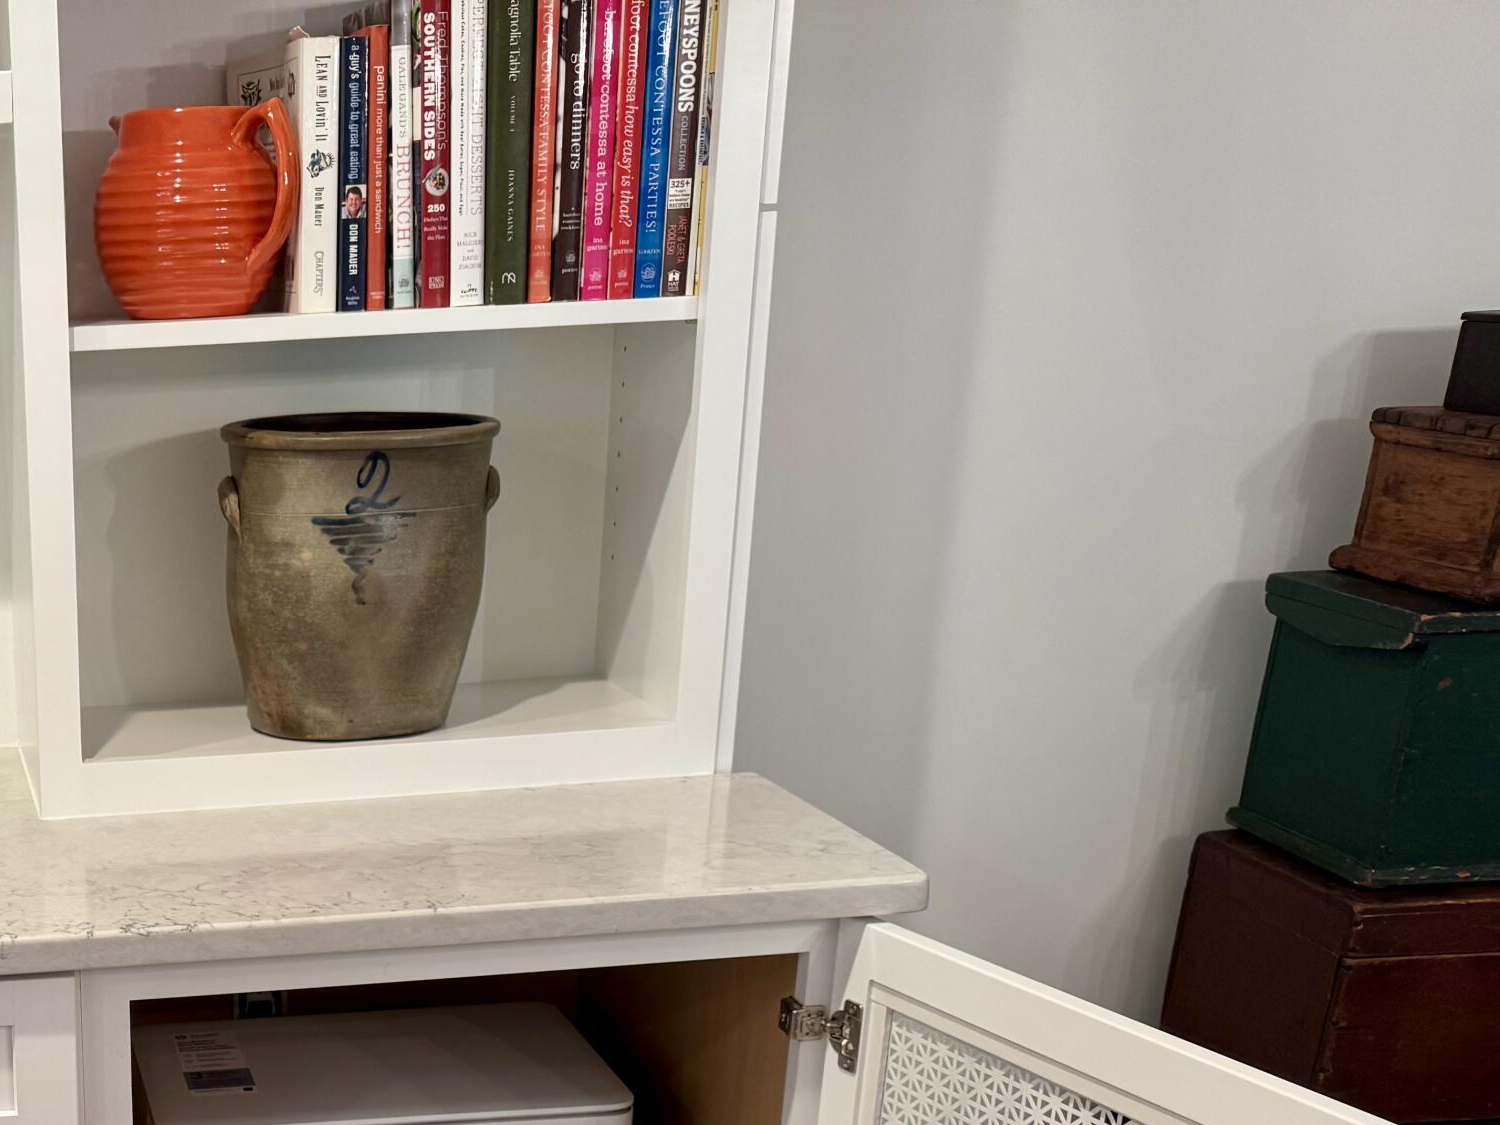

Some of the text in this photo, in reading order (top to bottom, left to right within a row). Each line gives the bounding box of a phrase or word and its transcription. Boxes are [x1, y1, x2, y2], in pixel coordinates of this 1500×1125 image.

[315, 55, 331, 81] LEAN
[349, 54, 360, 79] guy's
[509, 48, 520, 81] Table
[626, 35, 640, 102] contessa
[678, 0, 701, 113] NEYSPOONS
[348, 82, 360, 108] guide
[373, 65, 387, 105] panini
[424, 12, 435, 161] SOUTHERN SIDES
[437, 11, 449, 150] Fred Thompson's
[349, 111, 360, 120] to
[375, 108, 384, 135] more
[570, 53, 585, 170] go to dinners
[598, 85, 610, 156] contessa
[624, 104, 639, 137] how
[650, 65, 667, 156] CONTESSA
[348, 123, 360, 148] great
[375, 137, 384, 160] than
[677, 115, 689, 171] COLLECTION
[347, 151, 359, 179] eating
[374, 160, 384, 180] just
[470, 134, 485, 216] DESSERTS
[536, 131, 549, 184] FAMILY
[596, 161, 607, 177] at
[617, 140, 634, 173] easy
[396, 144, 411, 249] BRUNCH!
[619, 175, 635, 187] is
[645, 163, 660, 233] PARTIES!
[671, 180, 691, 188] 325+
[314, 187, 325, 227] Don Mauer
[373, 189, 385, 234] sandwich
[427, 204, 446, 213] 250
[535, 188, 547, 232] STYLE
[594, 182, 608, 226] home
[618, 190, 633, 228] that?
[348, 224, 358, 276] DON MAUER
[345, 451, 401, 515] 2
